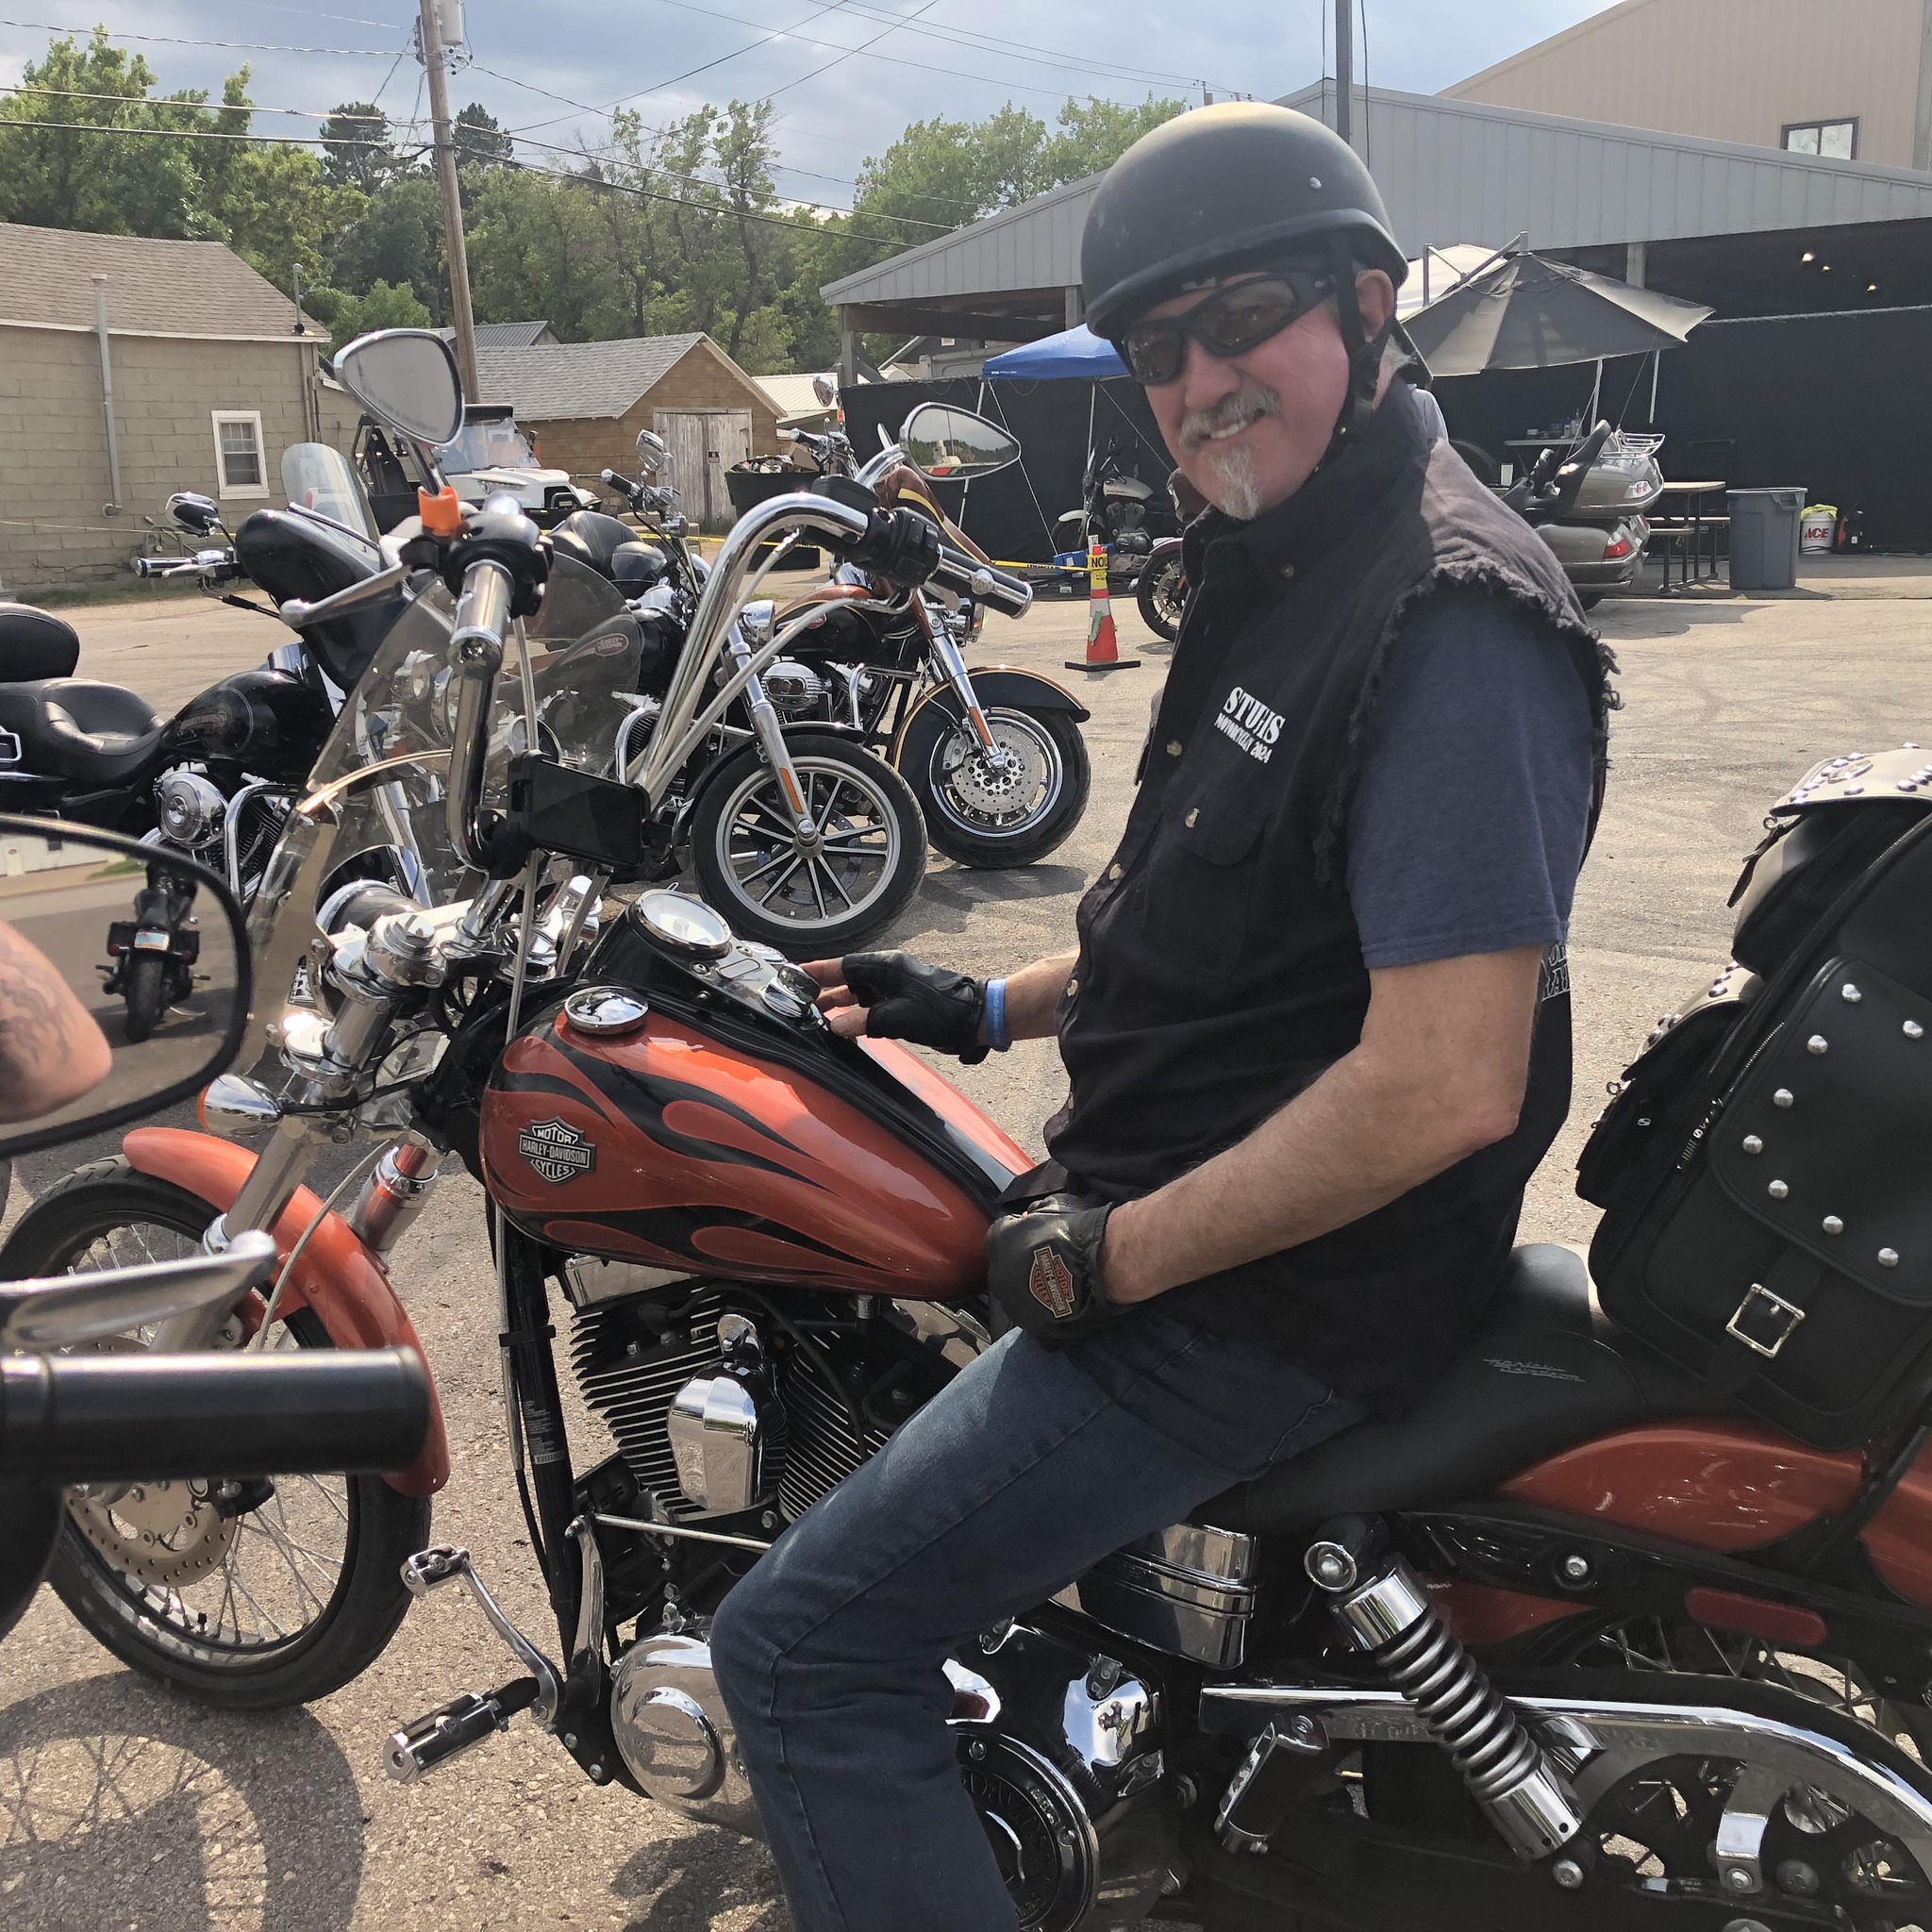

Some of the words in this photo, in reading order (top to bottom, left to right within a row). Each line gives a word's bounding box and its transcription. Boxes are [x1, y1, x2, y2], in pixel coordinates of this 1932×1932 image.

[1805, 528, 1829, 539] ACE
[537, 1126, 572, 1144] MOTOR
[522, 1139, 587, 1164] HARLEY-DAVIDSON
[535, 1160, 570, 1179] CYCLES
[1041, 1252, 1066, 1312] HARLEY-DAVIDSON
